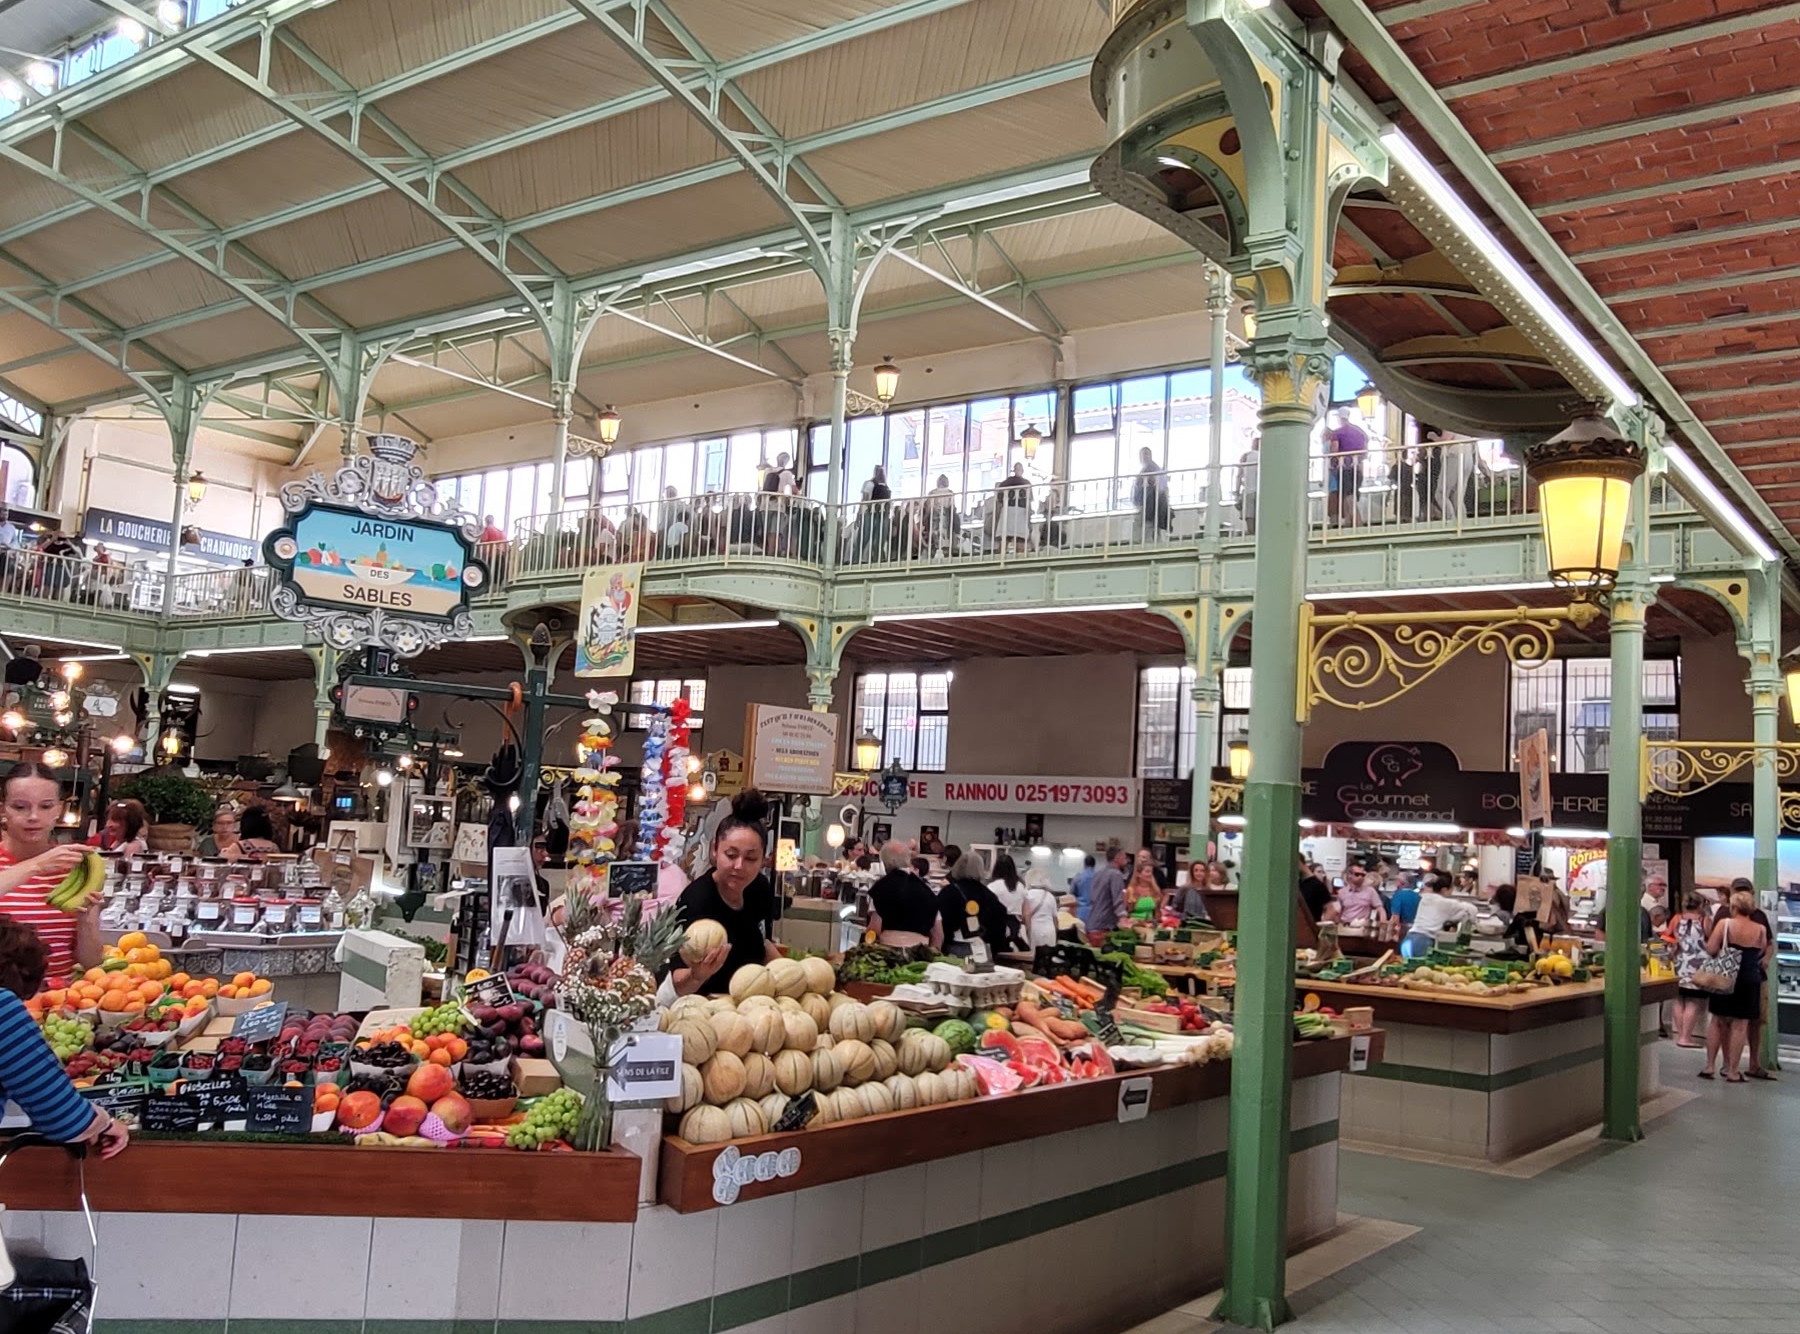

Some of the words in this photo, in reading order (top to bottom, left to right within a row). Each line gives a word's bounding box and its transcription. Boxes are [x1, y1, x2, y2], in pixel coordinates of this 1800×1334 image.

[100, 517, 113, 535] LA
[117, 520, 172, 546] BOUCHERIE
[200, 536, 253, 560] CHAUMOISE
[351, 520, 414, 543] JARDIN
[369, 569, 390, 580] DES
[343, 584, 412, 607] SABLES
[945, 782, 1008, 801] RANNOU
[1015, 784, 1128, 804] 0251973093
[1336, 785, 1431, 806] Gourmet
[1344, 801, 1455, 821] Gourmand
[616, 1068, 634, 1077] SENS
[635, 1068, 645, 1076] DE
[645, 1067, 655, 1076] LA
